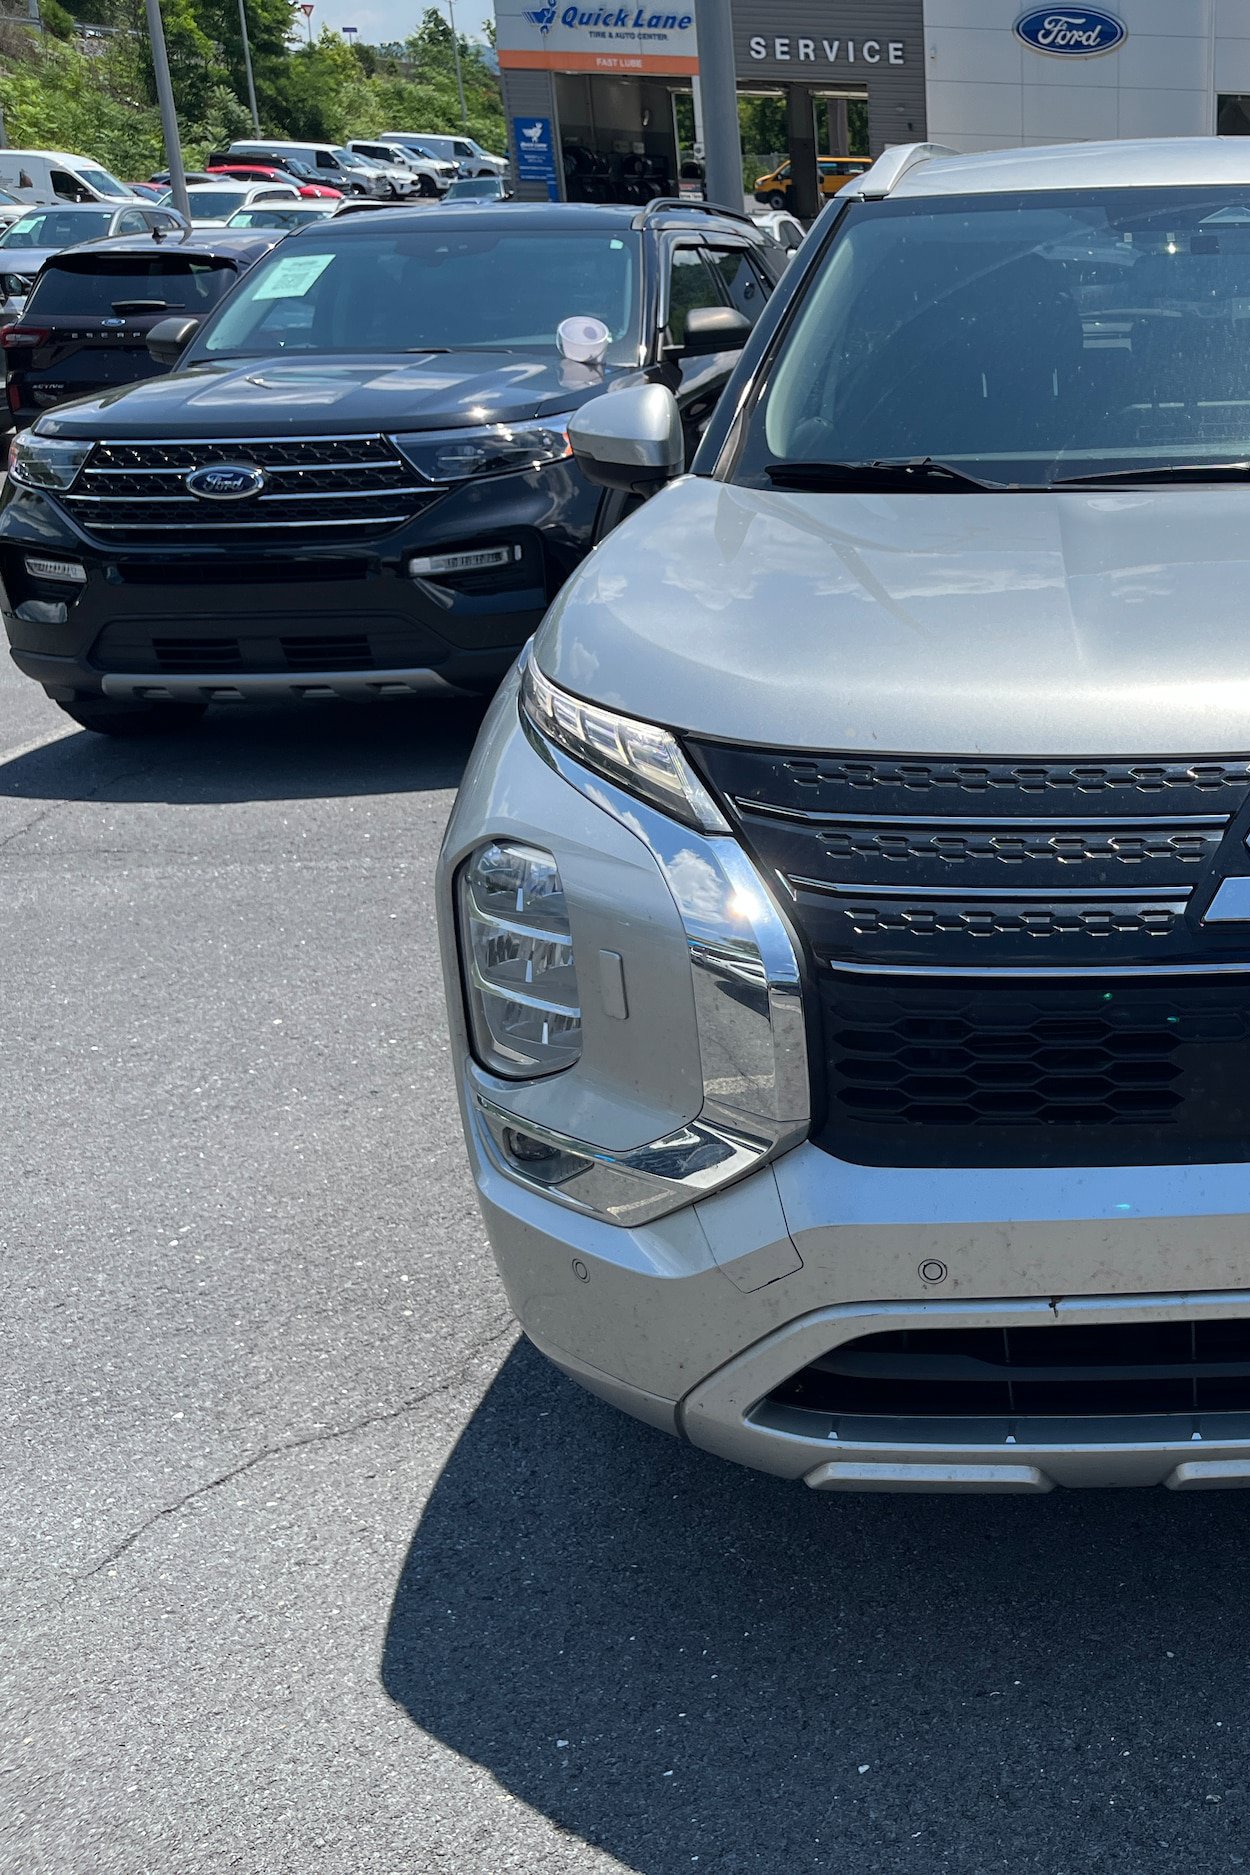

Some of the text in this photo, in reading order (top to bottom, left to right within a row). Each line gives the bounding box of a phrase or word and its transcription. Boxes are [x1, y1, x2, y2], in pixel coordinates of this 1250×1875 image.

[561, 6, 692, 30] Quick Lane
[589, 31, 606, 39] TIRE
[615, 32, 636, 40] AUTO
[1038, 15, 1102, 46] Ford
[750, 36, 905, 65] SERVICE
[597, 58, 643, 68] FAST LUBE
